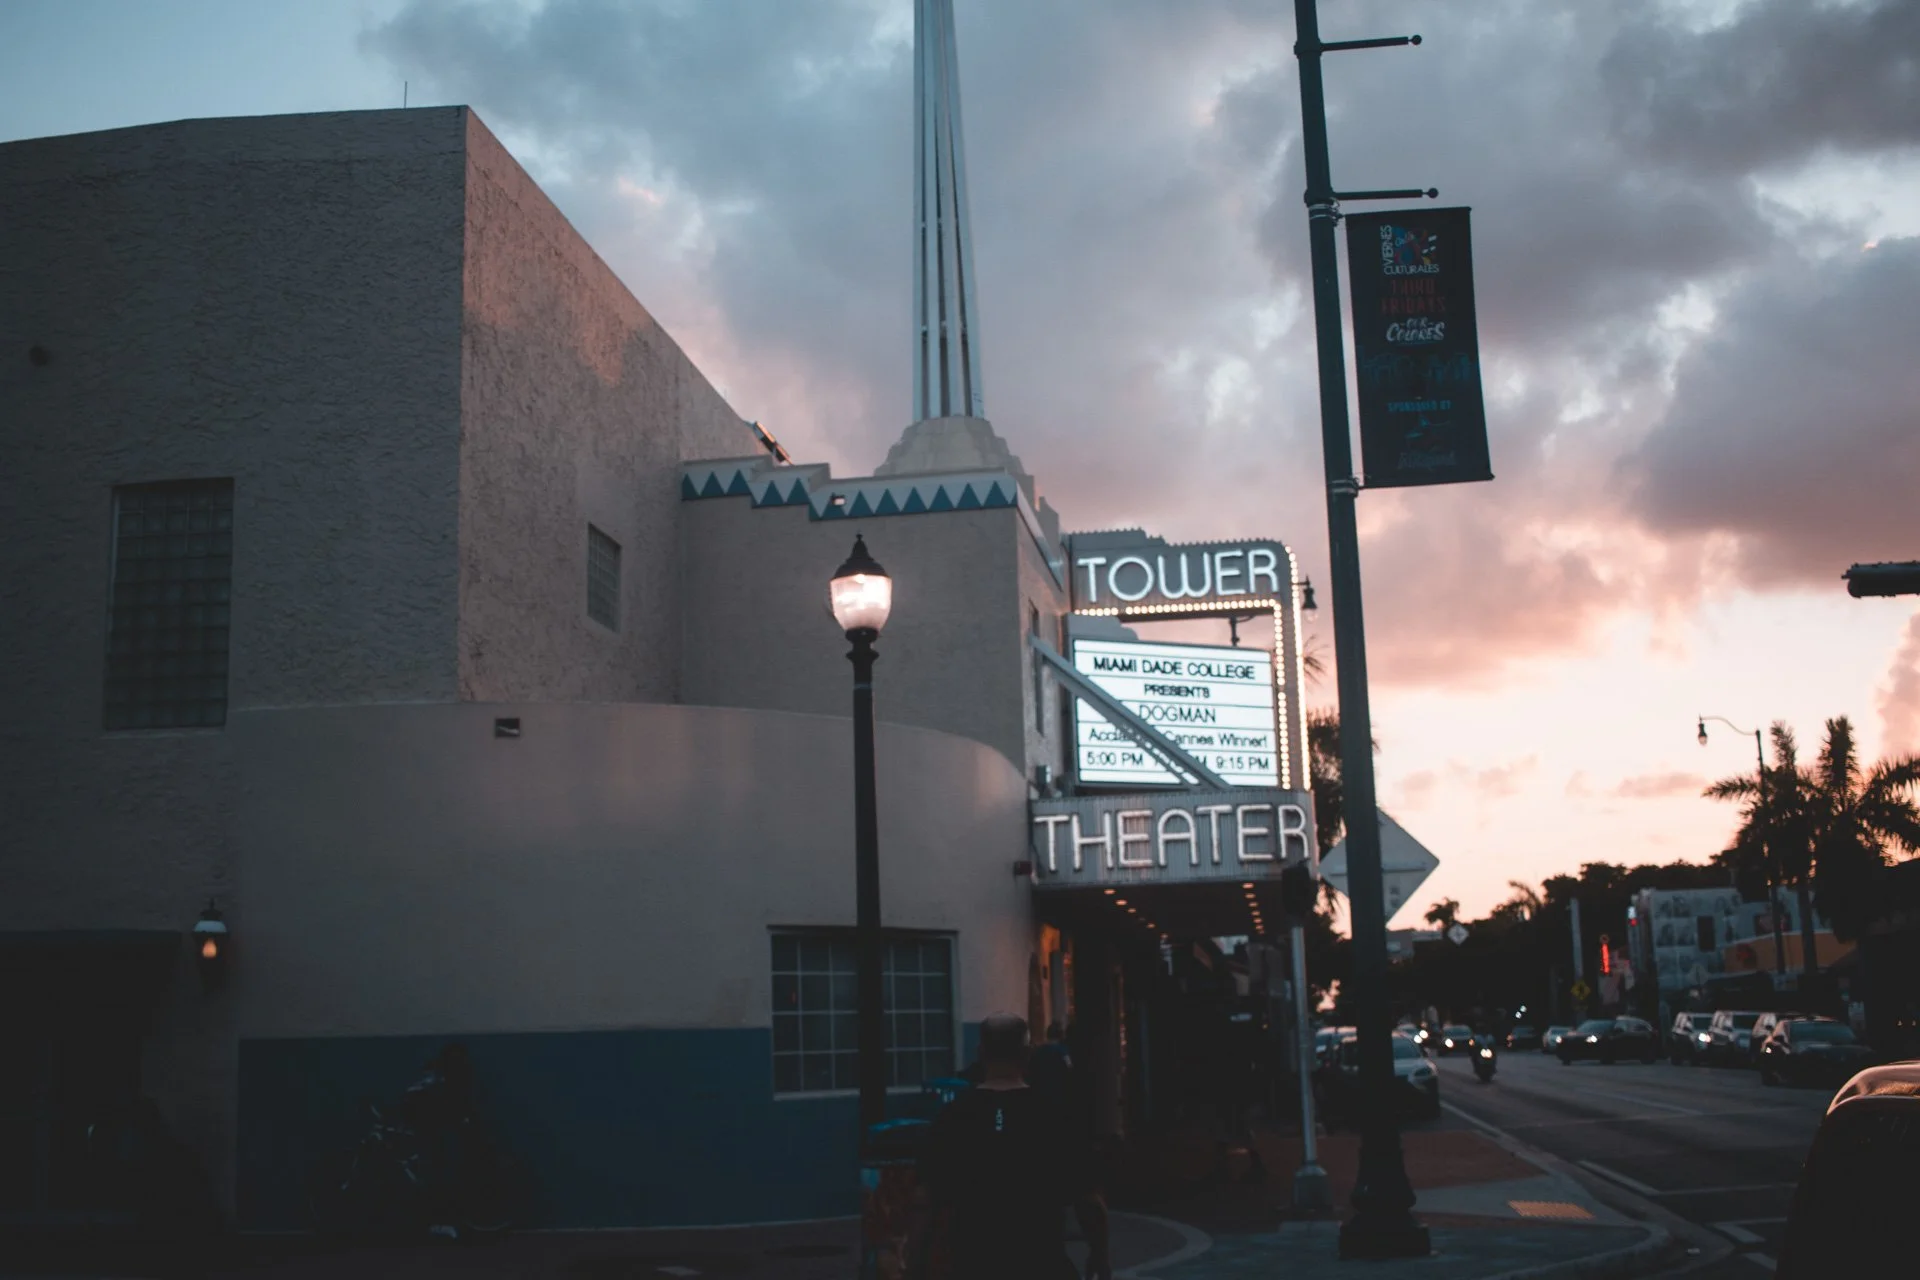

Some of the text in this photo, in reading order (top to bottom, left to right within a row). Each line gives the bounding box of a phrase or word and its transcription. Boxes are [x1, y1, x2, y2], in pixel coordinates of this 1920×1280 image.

[1384, 263, 1440, 276] CULTURALES
[1076, 548, 1280, 602] TOWER
[1094, 657, 1255, 680] MIAMI DADE COLLEGE
[1144, 683, 1211, 699] PRESENTS
[1139, 704, 1216, 723] DOGMAN
[1218, 732, 1268, 748] Winner!
[1087, 751, 1118, 765] 5:00
[1122, 752, 1144, 766] PM
[1216, 756, 1244, 769] 9:15
[1248, 757, 1269, 770] PM
[1034, 804, 1310, 871] THEATER
